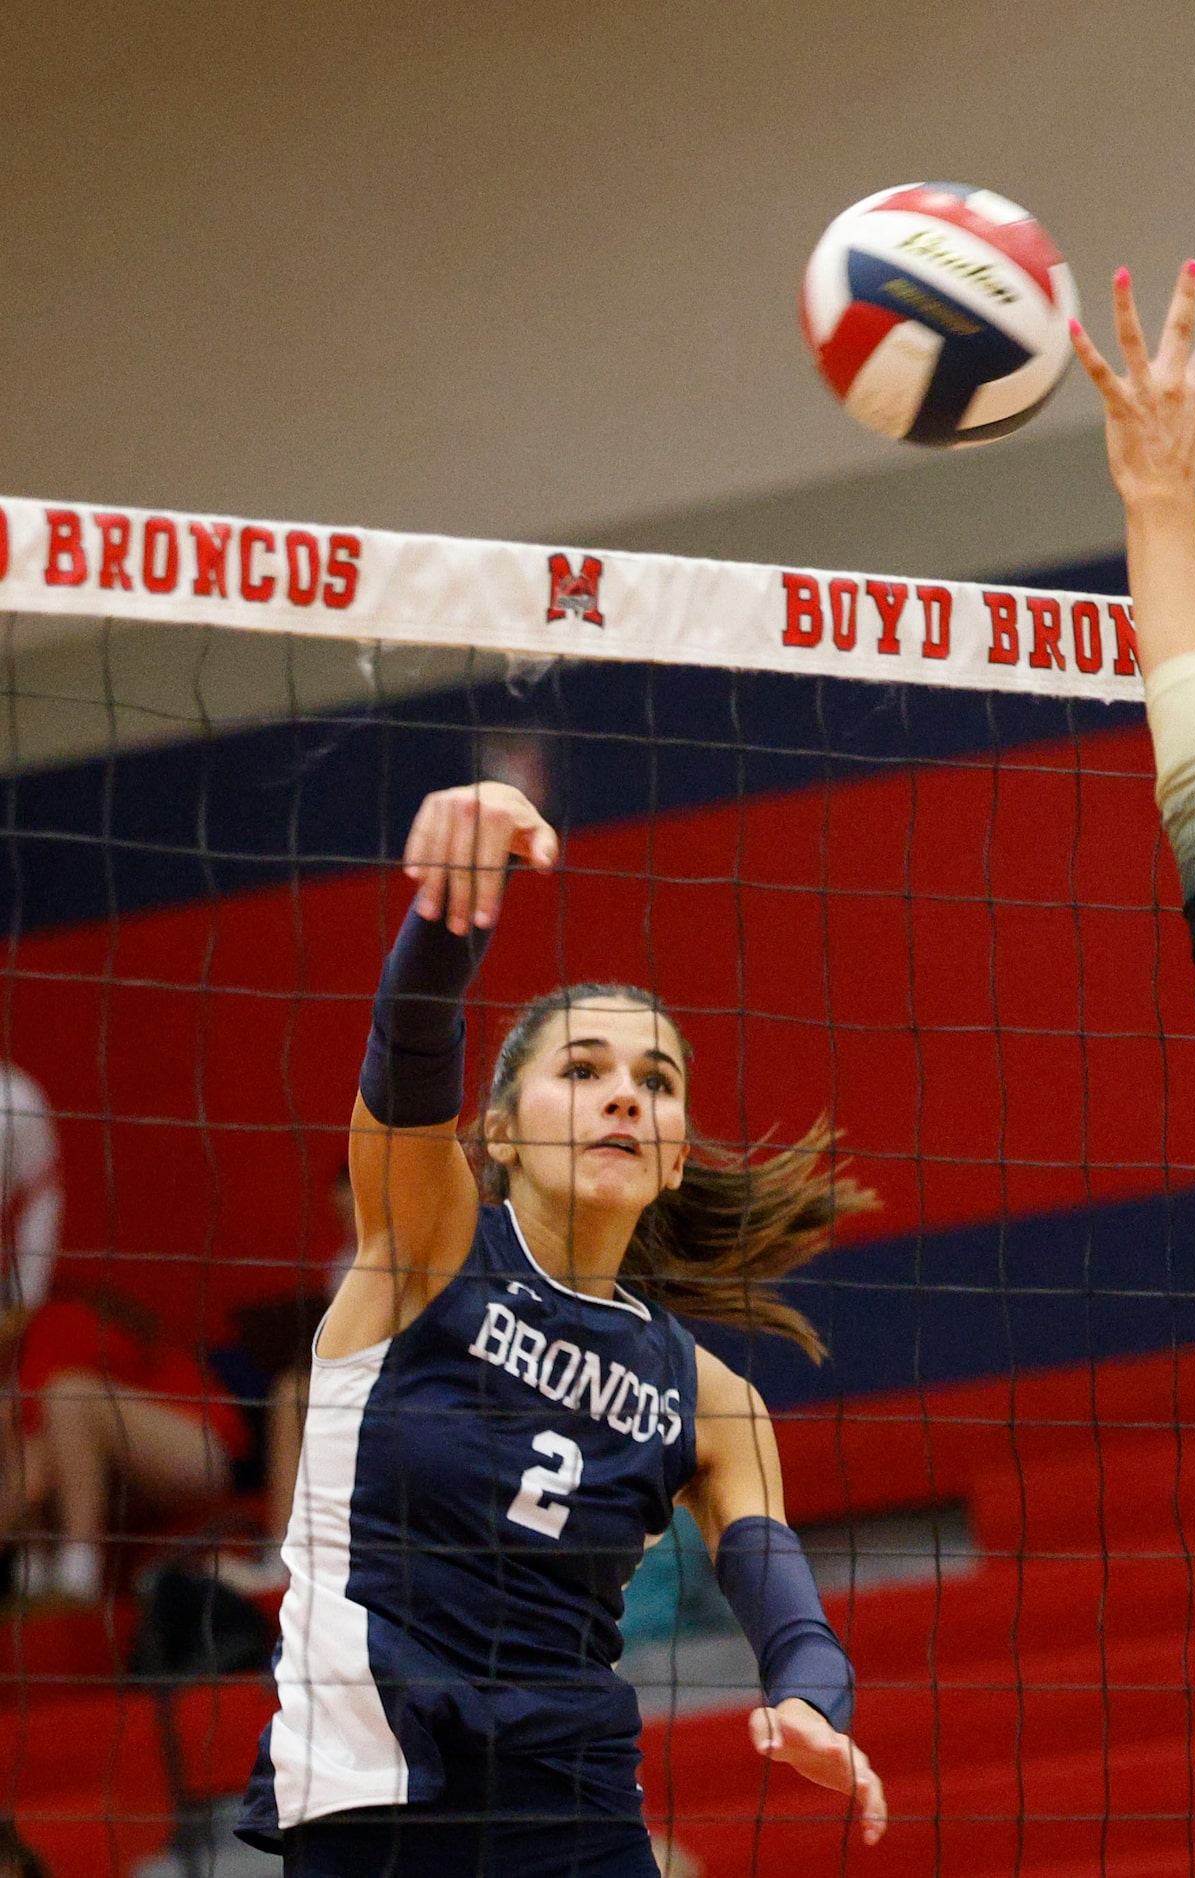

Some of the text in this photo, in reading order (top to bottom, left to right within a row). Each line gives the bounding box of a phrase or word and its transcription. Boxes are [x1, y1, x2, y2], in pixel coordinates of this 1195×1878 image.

[44, 507, 362, 609] BRONCOS
[780, 571, 953, 660] BOYD
[467, 1301, 683, 1446] BRONCOS
[505, 1429, 585, 1541] 2
